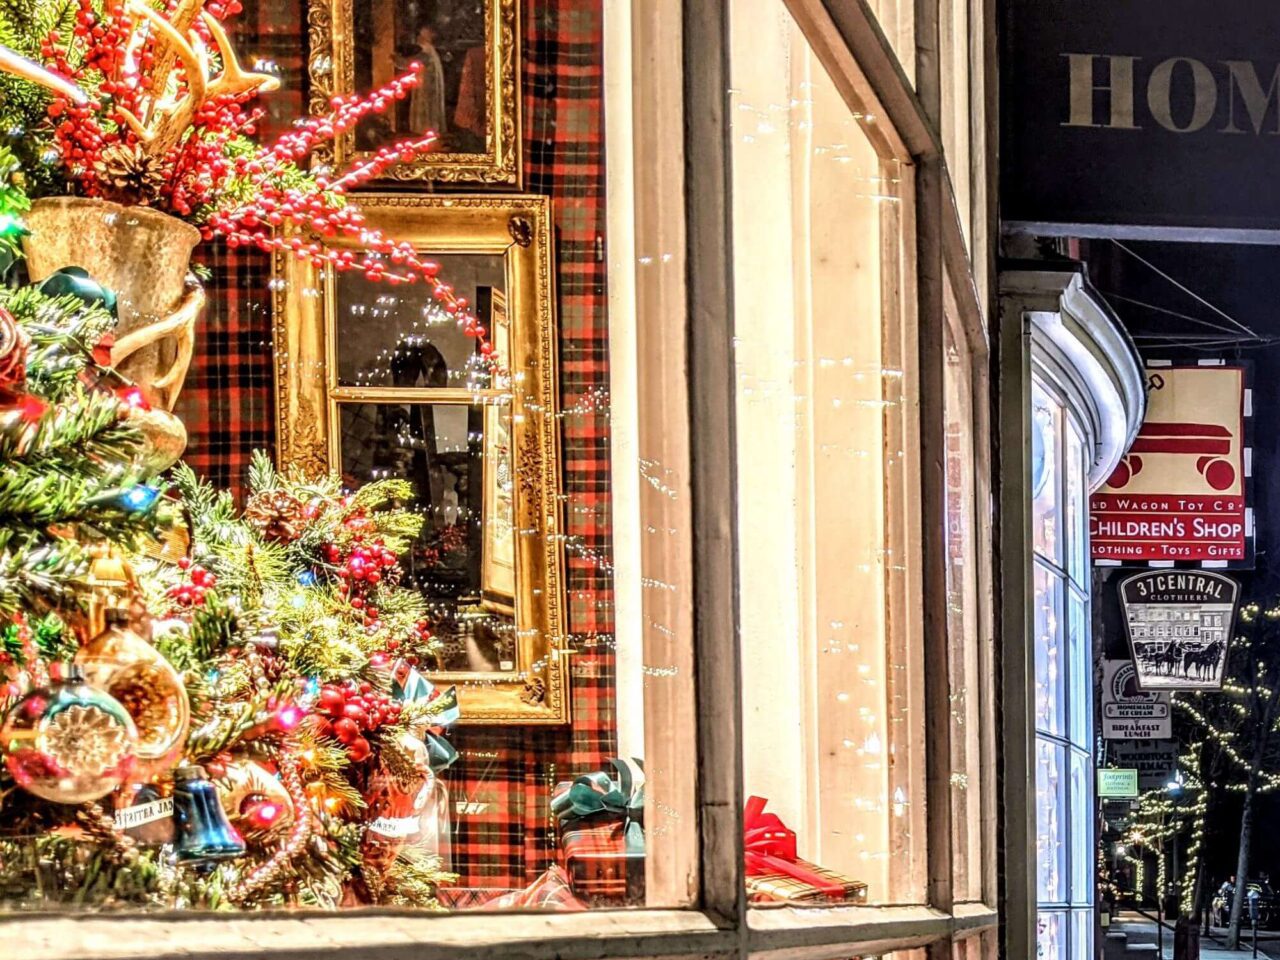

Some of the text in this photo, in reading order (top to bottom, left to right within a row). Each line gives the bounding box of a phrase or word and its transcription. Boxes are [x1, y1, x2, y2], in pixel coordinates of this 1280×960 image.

[1117, 500, 1169, 510] WAGON
[1178, 501, 1204, 511] TOY
[1193, 518, 1242, 538] SHOP
[1092, 545, 1241, 555] LOTHING TOYS GIFTS
